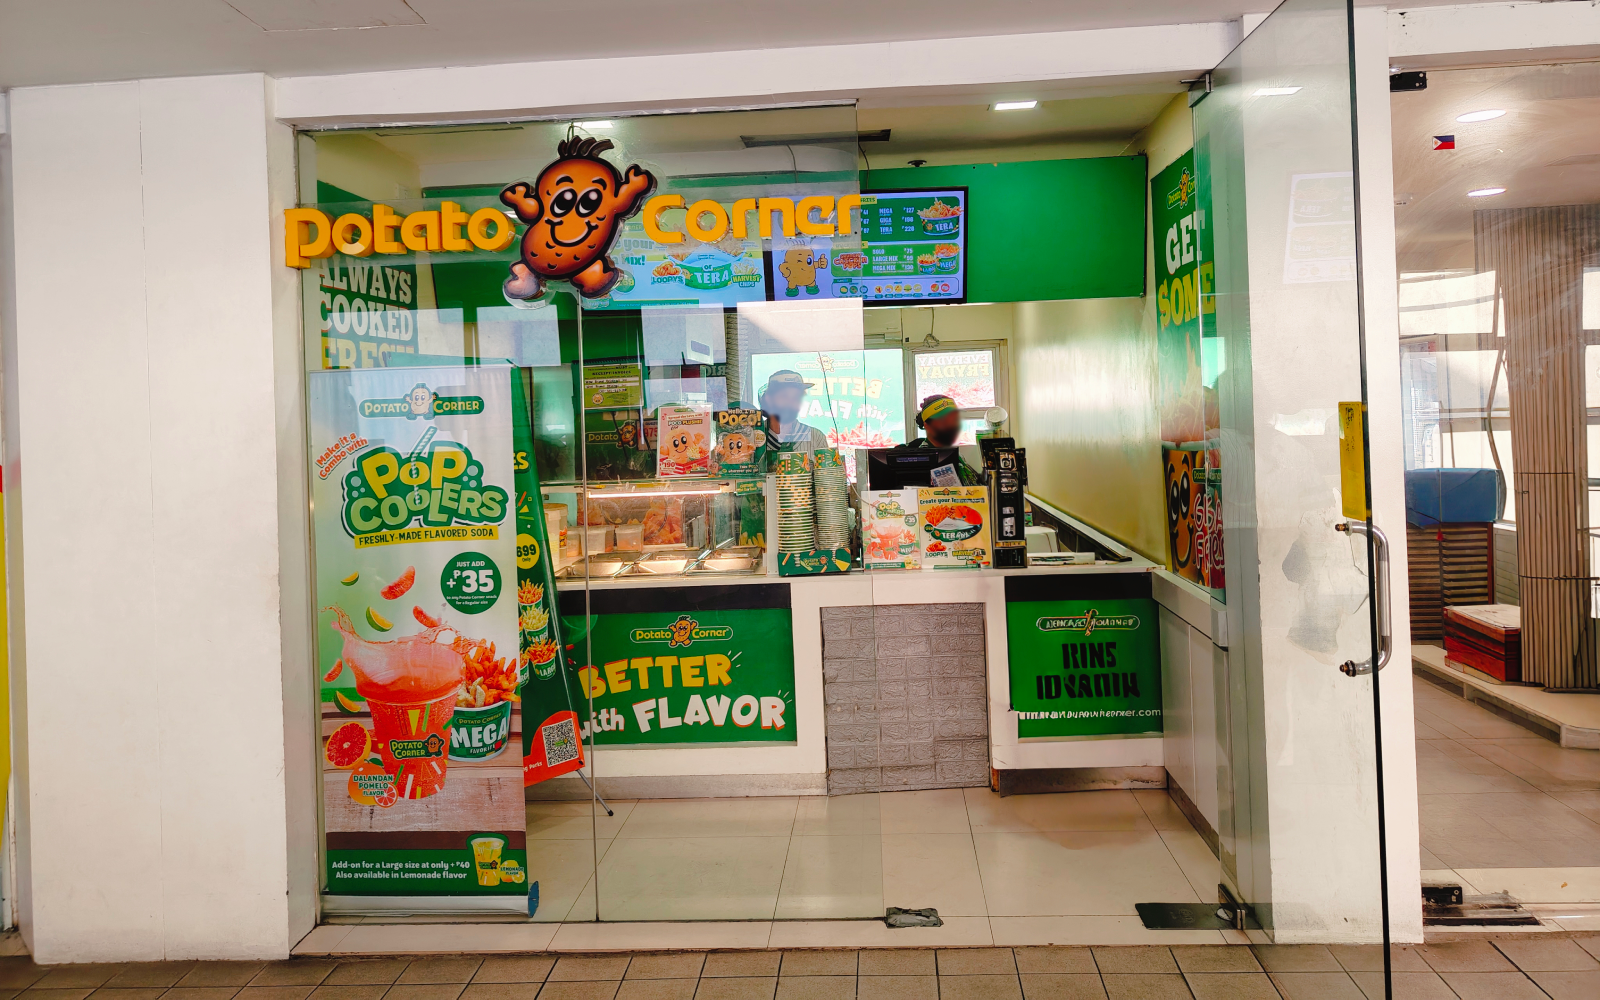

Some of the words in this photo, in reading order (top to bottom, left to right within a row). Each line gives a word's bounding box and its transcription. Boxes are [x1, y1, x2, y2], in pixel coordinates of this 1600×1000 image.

[1165, 210, 1206, 275] GET
[319, 252, 412, 304] ALWAYS
[694, 271, 729, 284] TERA
[1158, 261, 1216, 333] SOME
[321, 291, 414, 342] COOKED
[316, 442, 341, 466] Make
[339, 436, 350, 446] it
[346, 437, 368, 453] with
[350, 482, 503, 531] COOLERS
[359, 531, 422, 546] FRESHLY-MADE
[424, 529, 468, 539] FLAVORED
[470, 528, 494, 537] SODA
[636, 630, 672, 640] Potato
[578, 653, 733, 700] BETTER
[632, 694, 787, 734] FLAVOR
[451, 717, 508, 748] MEGA
[391, 741, 423, 751] POTATO
[395, 749, 426, 758] CORNER
[358, 782, 389, 790] POMELO
[332, 861, 361, 869] Add-on
[381, 861, 404, 871] Large
[430, 861, 449, 871] only
[335, 871, 353, 879] Also
[353, 871, 390, 879] available
[400, 871, 441, 879] Lemonade
[442, 871, 467, 879] flavor
